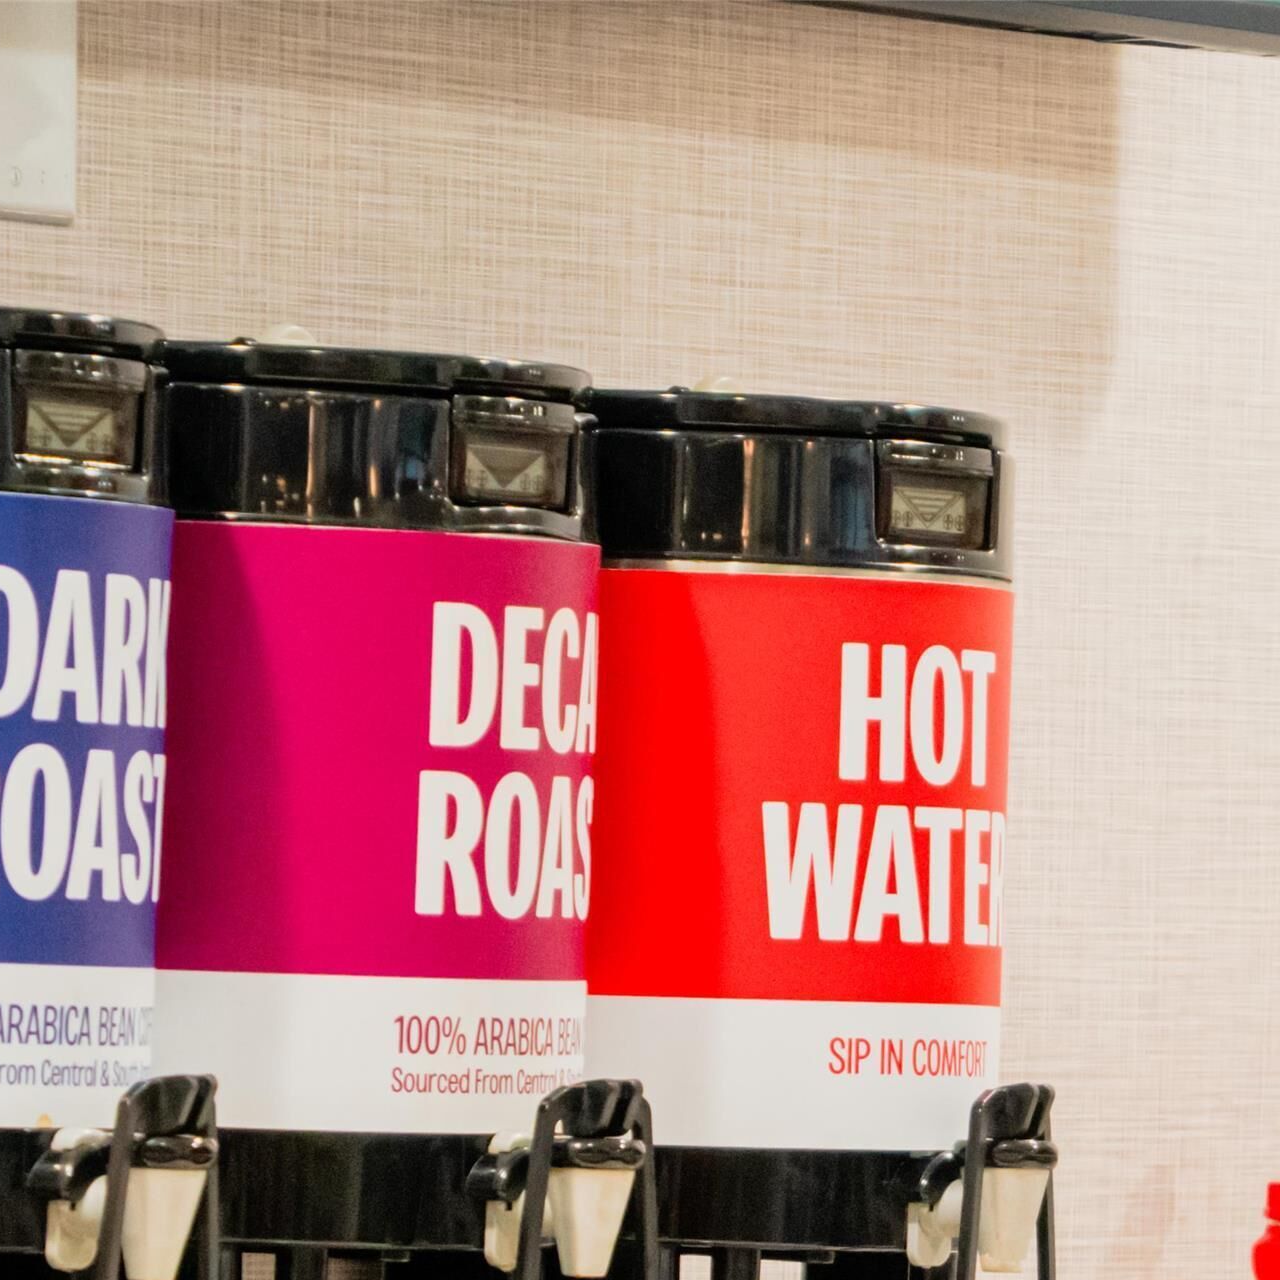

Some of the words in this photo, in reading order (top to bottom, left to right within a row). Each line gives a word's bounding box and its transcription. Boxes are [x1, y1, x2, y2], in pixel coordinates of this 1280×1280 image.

[428, 601, 599, 755] DECA
[838, 641, 997, 788] HOT
[414, 769, 595, 921] ROAS
[761, 800, 1007, 948] WATER
[98, 1006, 135, 1047] BEAN
[393, 1015, 467, 1056] 100%
[473, 1016, 554, 1057] ARABICA
[40, 1059, 97, 1088] Central
[100, 1059, 110, 1088] &
[828, 1036, 872, 1076] SIP
[880, 1038, 904, 1076] IN
[912, 1039, 988, 1078] COMFORT
[391, 1066, 471, 1095] Sourced
[474, 1068, 514, 1095] From
